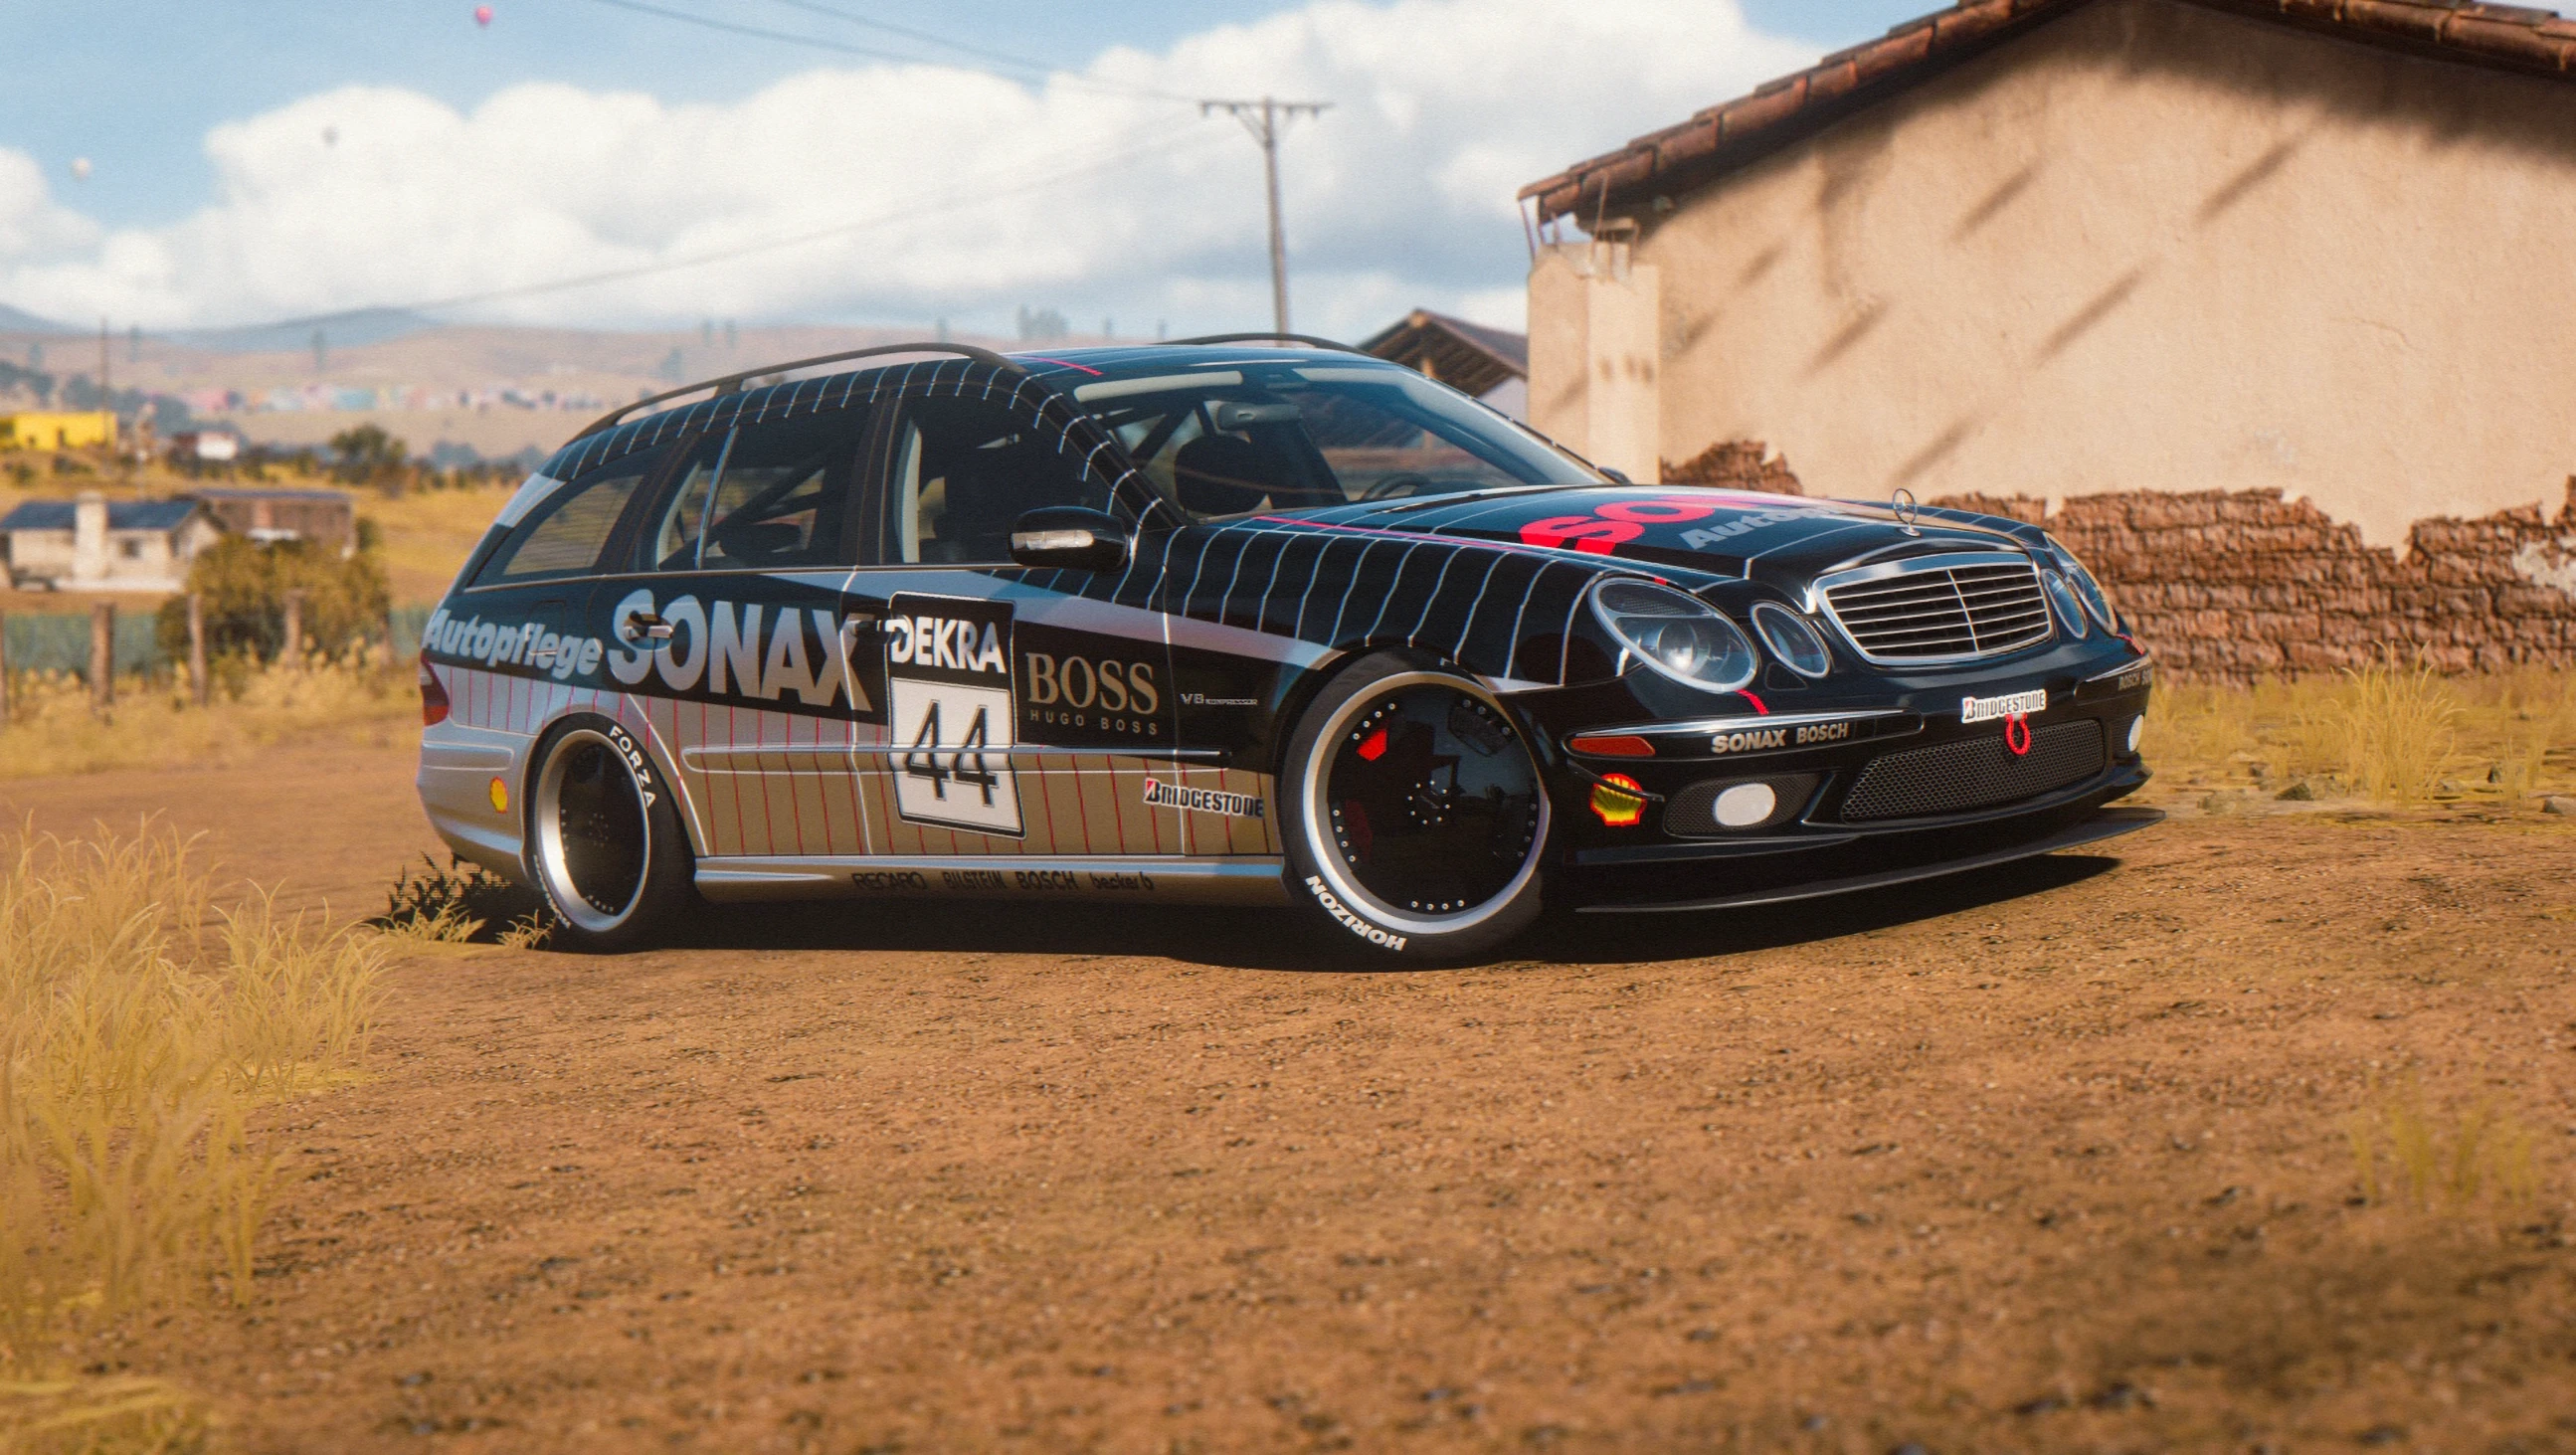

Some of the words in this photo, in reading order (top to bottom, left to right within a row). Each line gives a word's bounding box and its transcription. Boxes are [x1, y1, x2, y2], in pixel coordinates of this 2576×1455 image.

[421, 610, 603, 680] Autopflege
[608, 589, 873, 712] SONAX
[888, 615, 1007, 673] DEKRA
[1025, 652, 1159, 714] BOSS
[1180, 693, 1203, 705] V8
[1964, 692, 2045, 720] BRIDGESTONE
[1030, 709, 1084, 727] HUGO
[1101, 717, 1158, 735] BOSS
[1711, 729, 1786, 754] SONAX
[1796, 722, 1849, 744] BOSCH
[609, 725, 656, 808] FORZA
[905, 699, 1000, 808] 44
[1145, 779, 1264, 818] BRIDGESTONE
[851, 871, 928, 890] RECARO
[942, 870, 1008, 890] BILSTEIN
[1014, 870, 1079, 890] BOSCH
[1304, 875, 1407, 951] HORIZON
